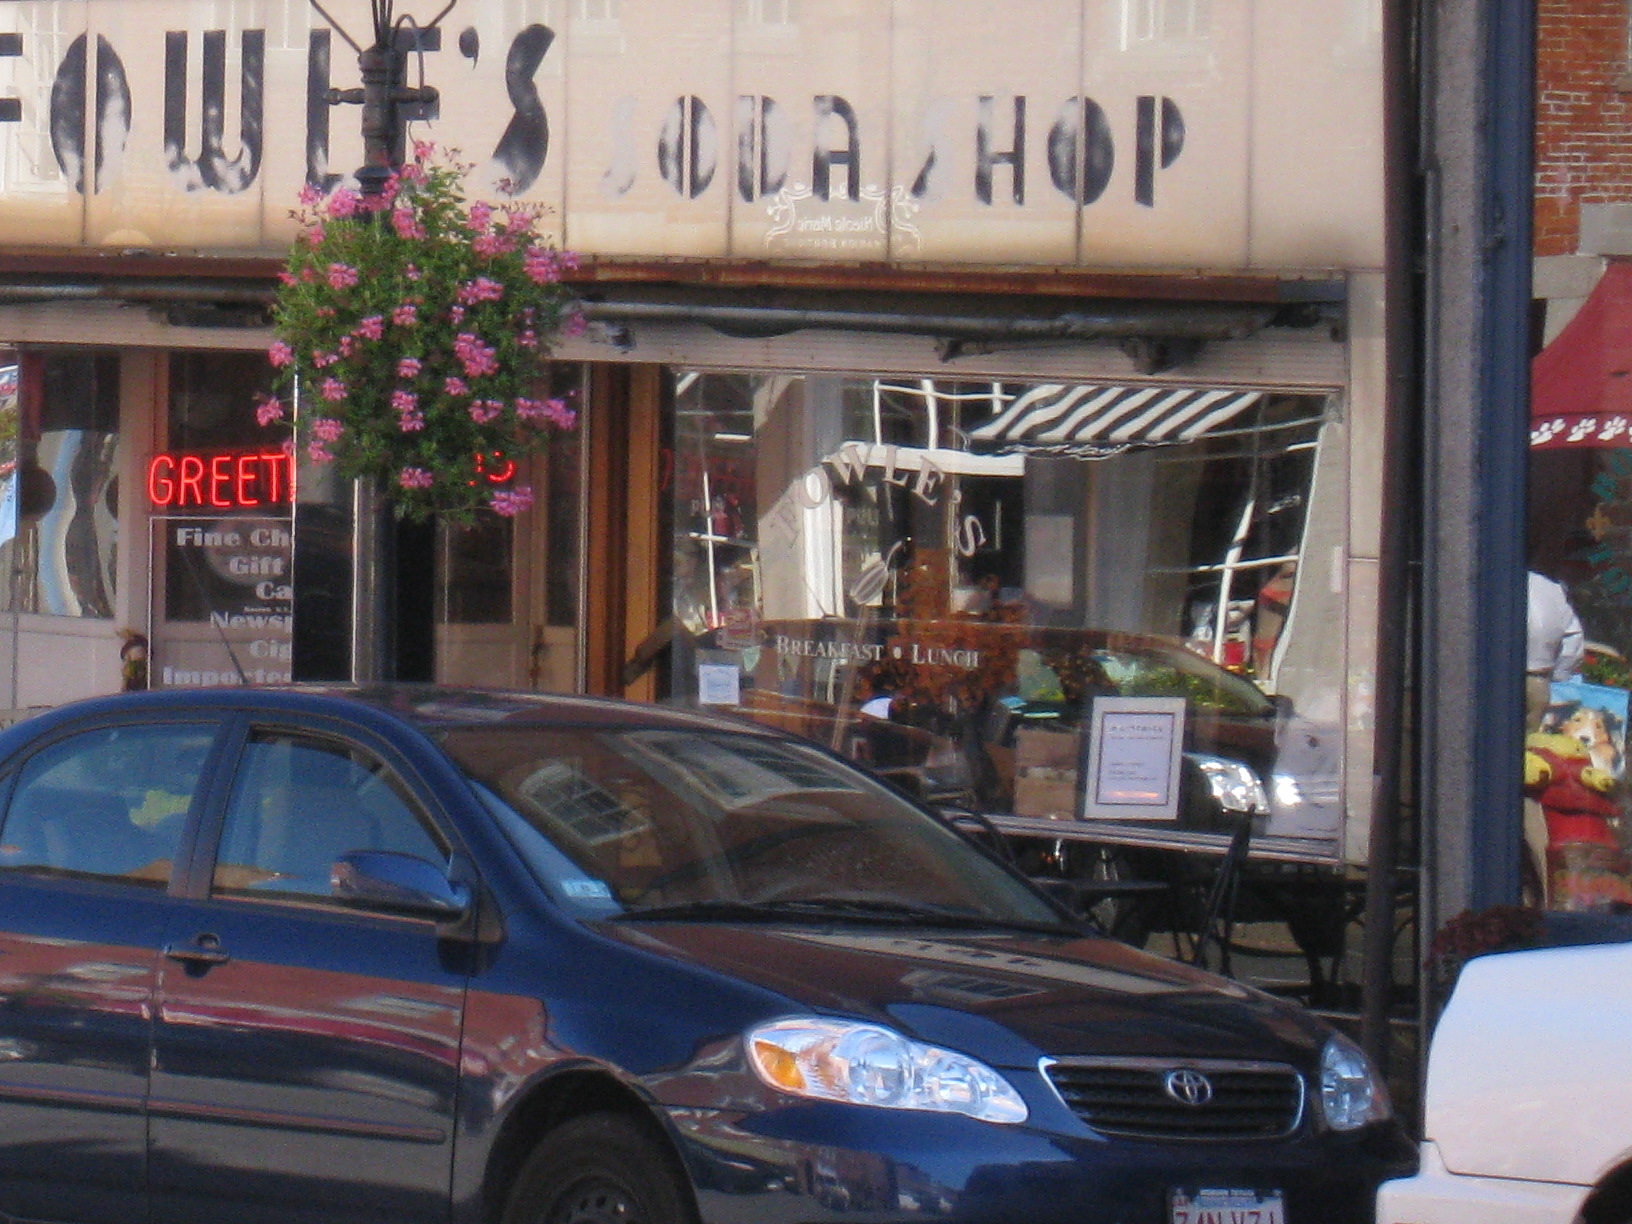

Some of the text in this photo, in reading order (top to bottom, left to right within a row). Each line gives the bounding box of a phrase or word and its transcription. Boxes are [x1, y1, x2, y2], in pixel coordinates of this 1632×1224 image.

[176, 527, 242, 547] Fine
[229, 555, 285, 576] Gift
[775, 634, 980, 669] BREAKFAST LUNCH
